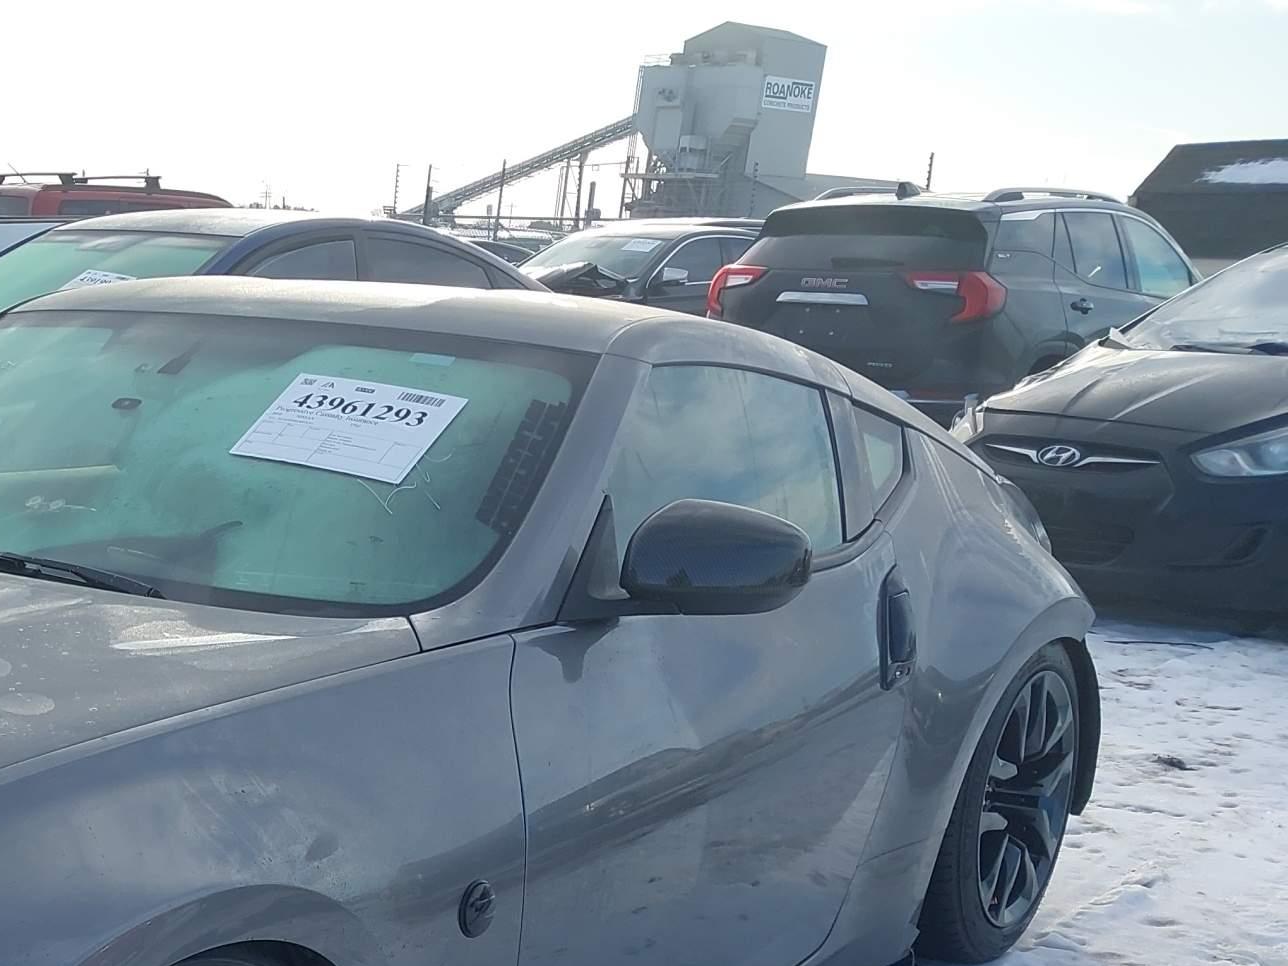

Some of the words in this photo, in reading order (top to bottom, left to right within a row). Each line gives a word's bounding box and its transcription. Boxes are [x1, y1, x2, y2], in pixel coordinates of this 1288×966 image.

[765, 81, 813, 99] ROANOKE
[800, 277, 849, 289] GMC
[292, 392, 429, 428] 43961293
